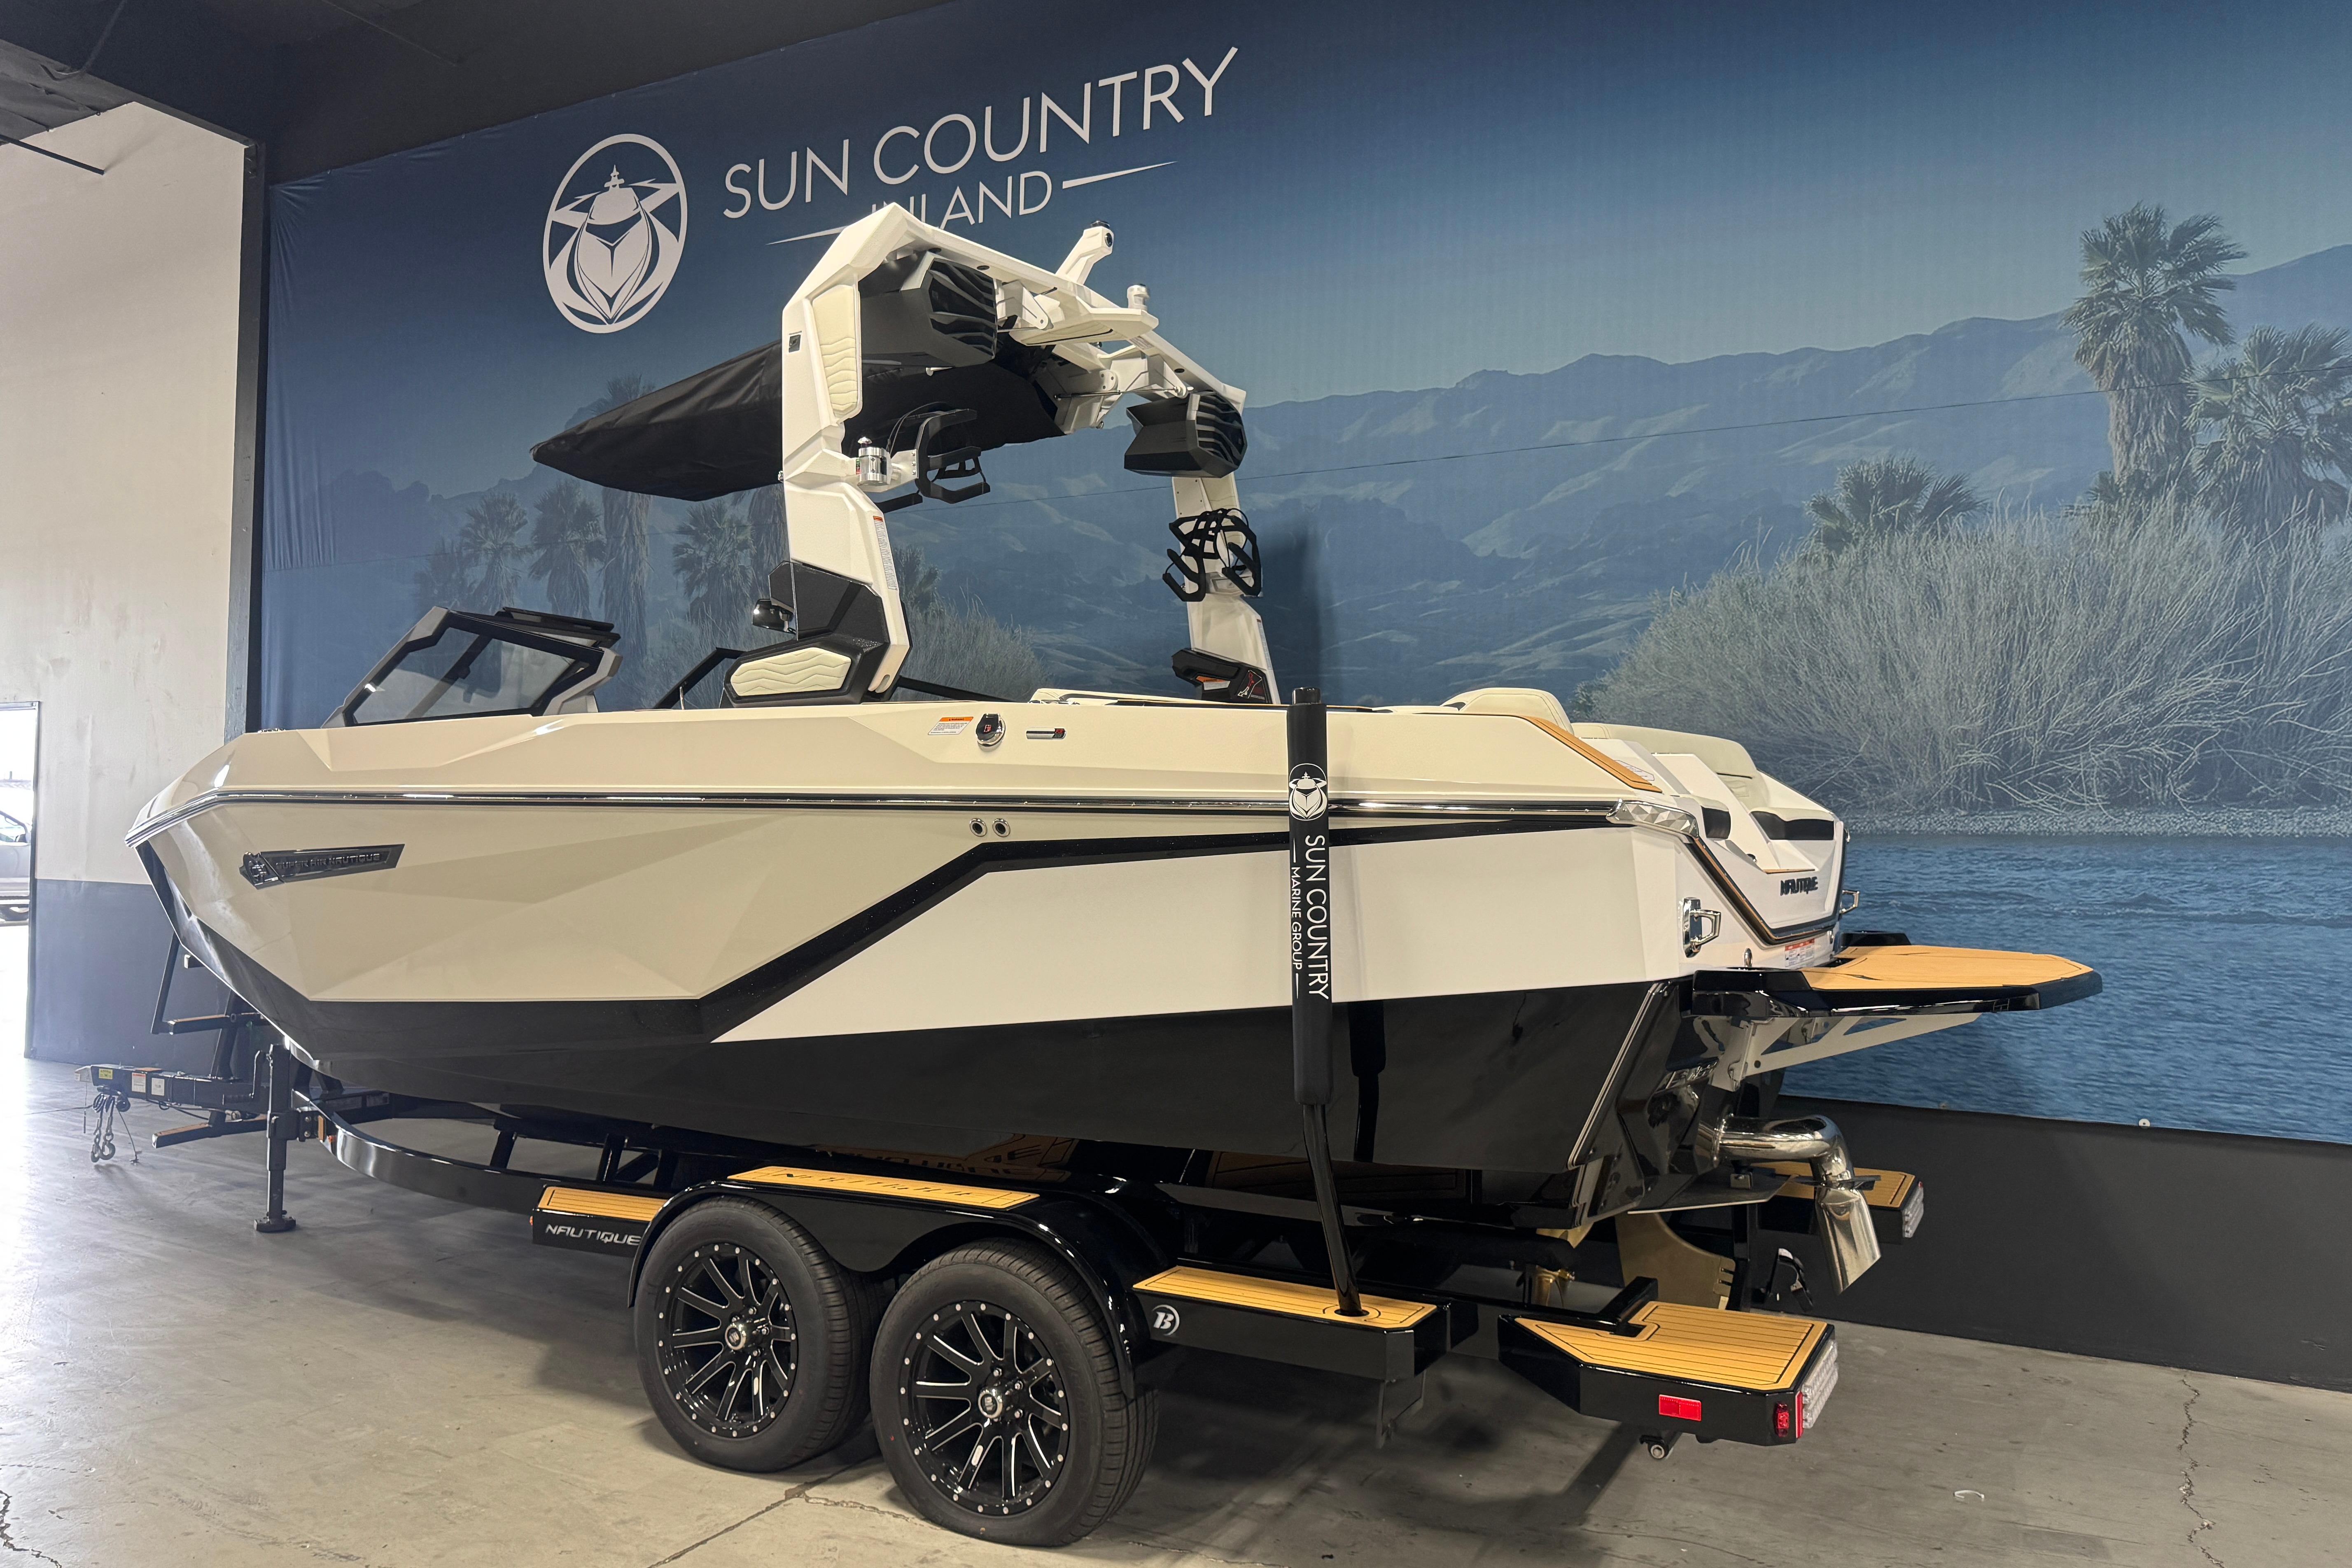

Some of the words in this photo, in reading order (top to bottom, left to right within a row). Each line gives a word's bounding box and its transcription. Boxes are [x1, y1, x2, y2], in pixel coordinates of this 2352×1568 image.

[723, 138, 849, 219] SUN
[873, 46, 1239, 185] COUNTRY
[310, 859, 327, 867] AIR
[329, 853, 380, 865] NAUTIQUE
[1304, 835, 1326, 881] SUN
[1291, 866, 1301, 918] MARINE
[1780, 876, 1819, 896] NAUTIQUE
[1291, 921, 1303, 970] GROUP
[1306, 888, 1329, 1000] COUNTRY
[544, 1223, 642, 1247] NAUTIQUE
